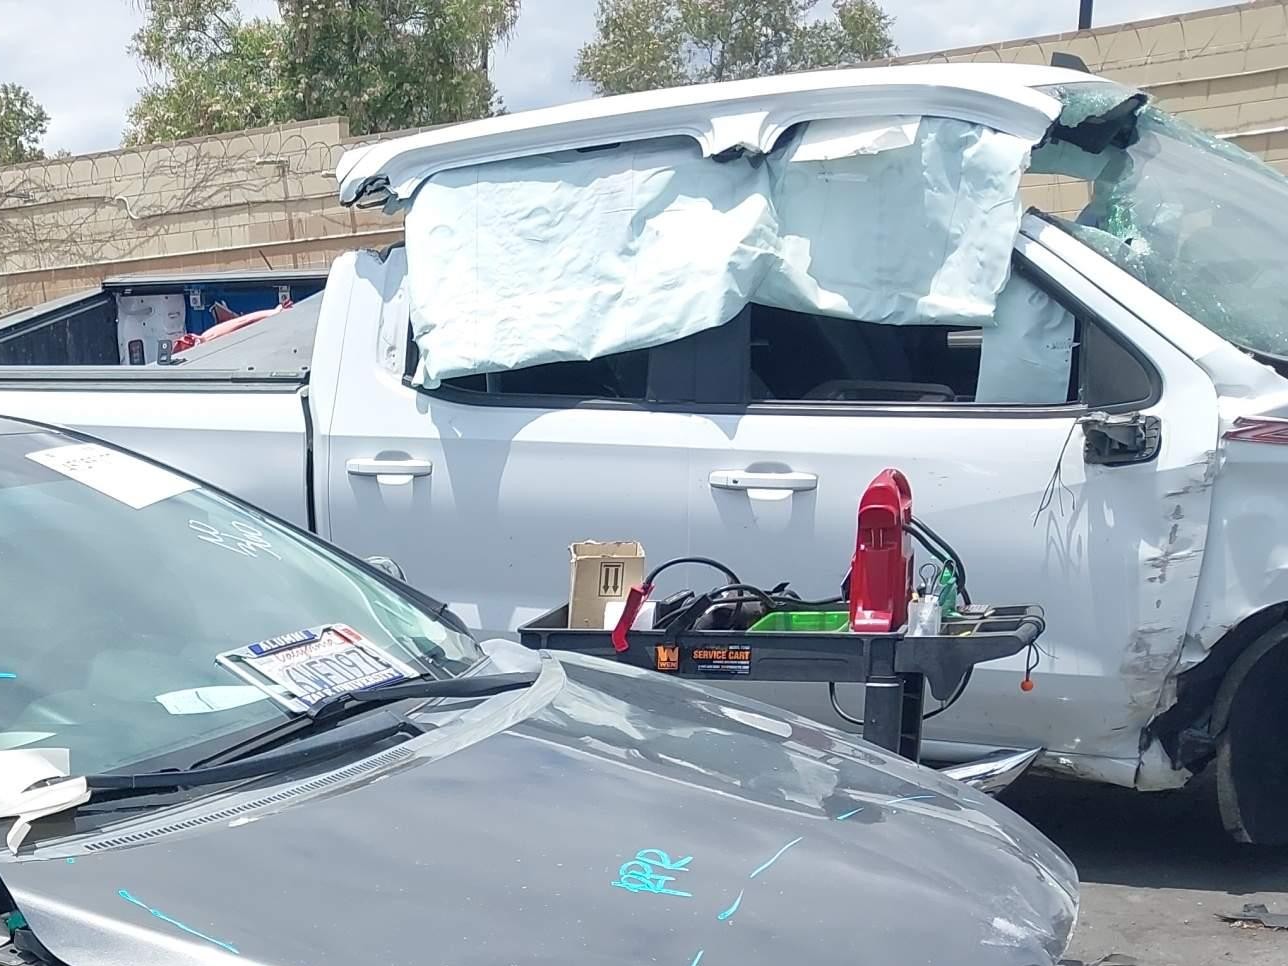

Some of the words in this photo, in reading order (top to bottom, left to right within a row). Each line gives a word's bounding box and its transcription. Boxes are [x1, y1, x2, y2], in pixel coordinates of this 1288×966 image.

[259, 630, 307, 652] ALUMNI
[693, 650, 727, 660] SERVICE
[728, 651, 750, 660] CART
[333, 668, 396, 693] UNIVERSITY
